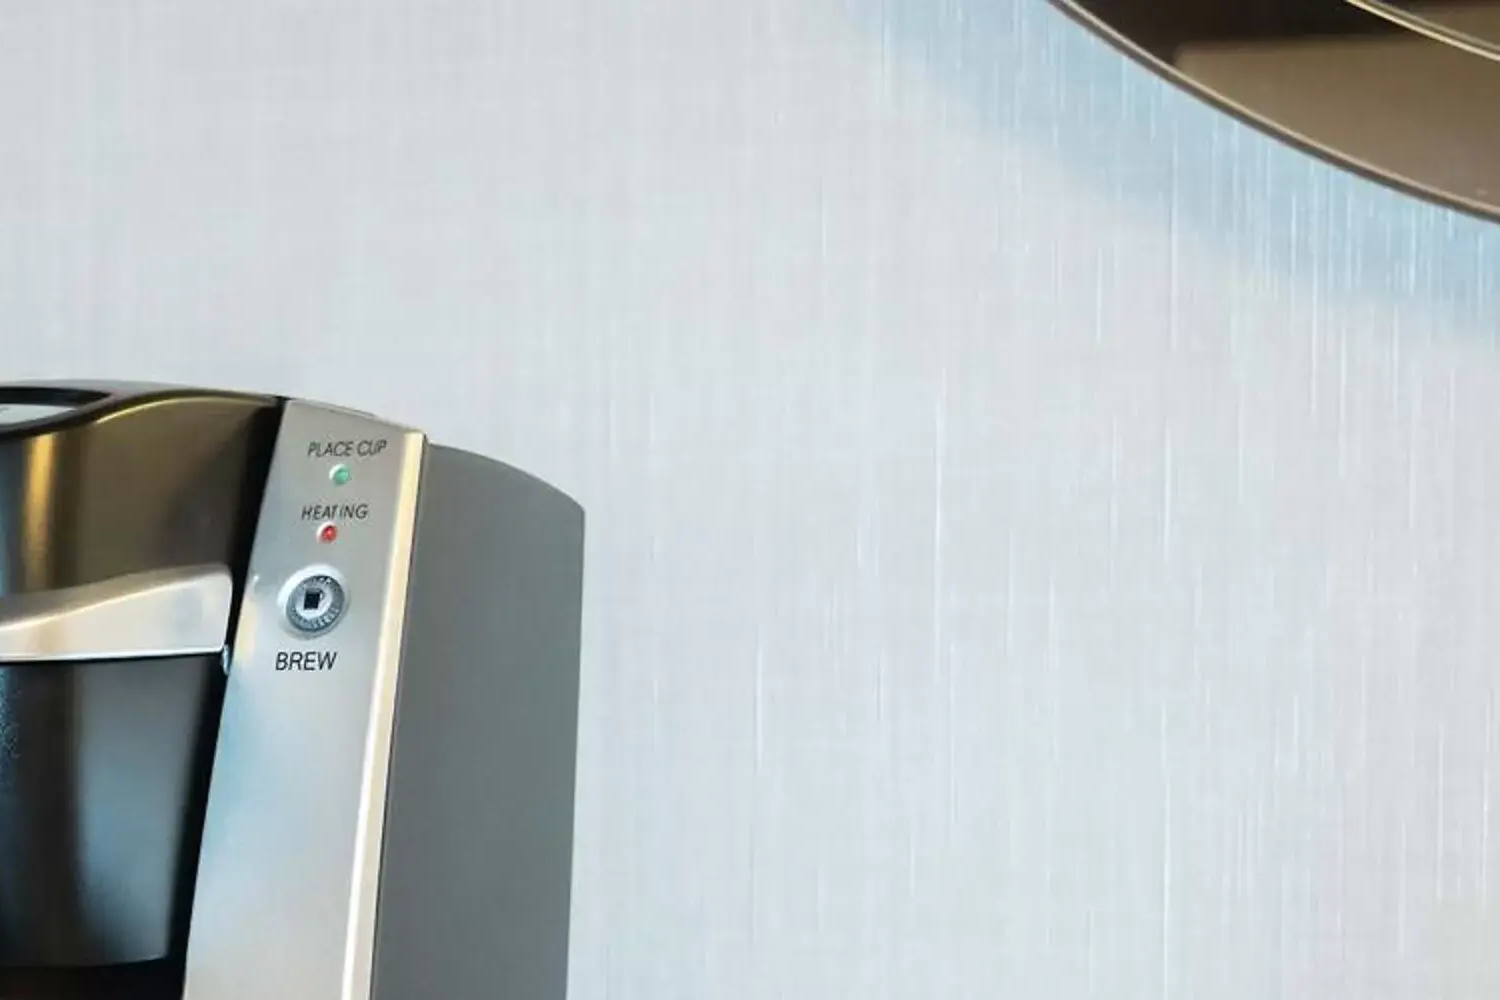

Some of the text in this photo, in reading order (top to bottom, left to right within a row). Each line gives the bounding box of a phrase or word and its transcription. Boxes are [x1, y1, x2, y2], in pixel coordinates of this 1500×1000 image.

[307, 439, 387, 457] PLACE CUP
[301, 503, 369, 520] HEATING
[275, 651, 338, 671] BREW
